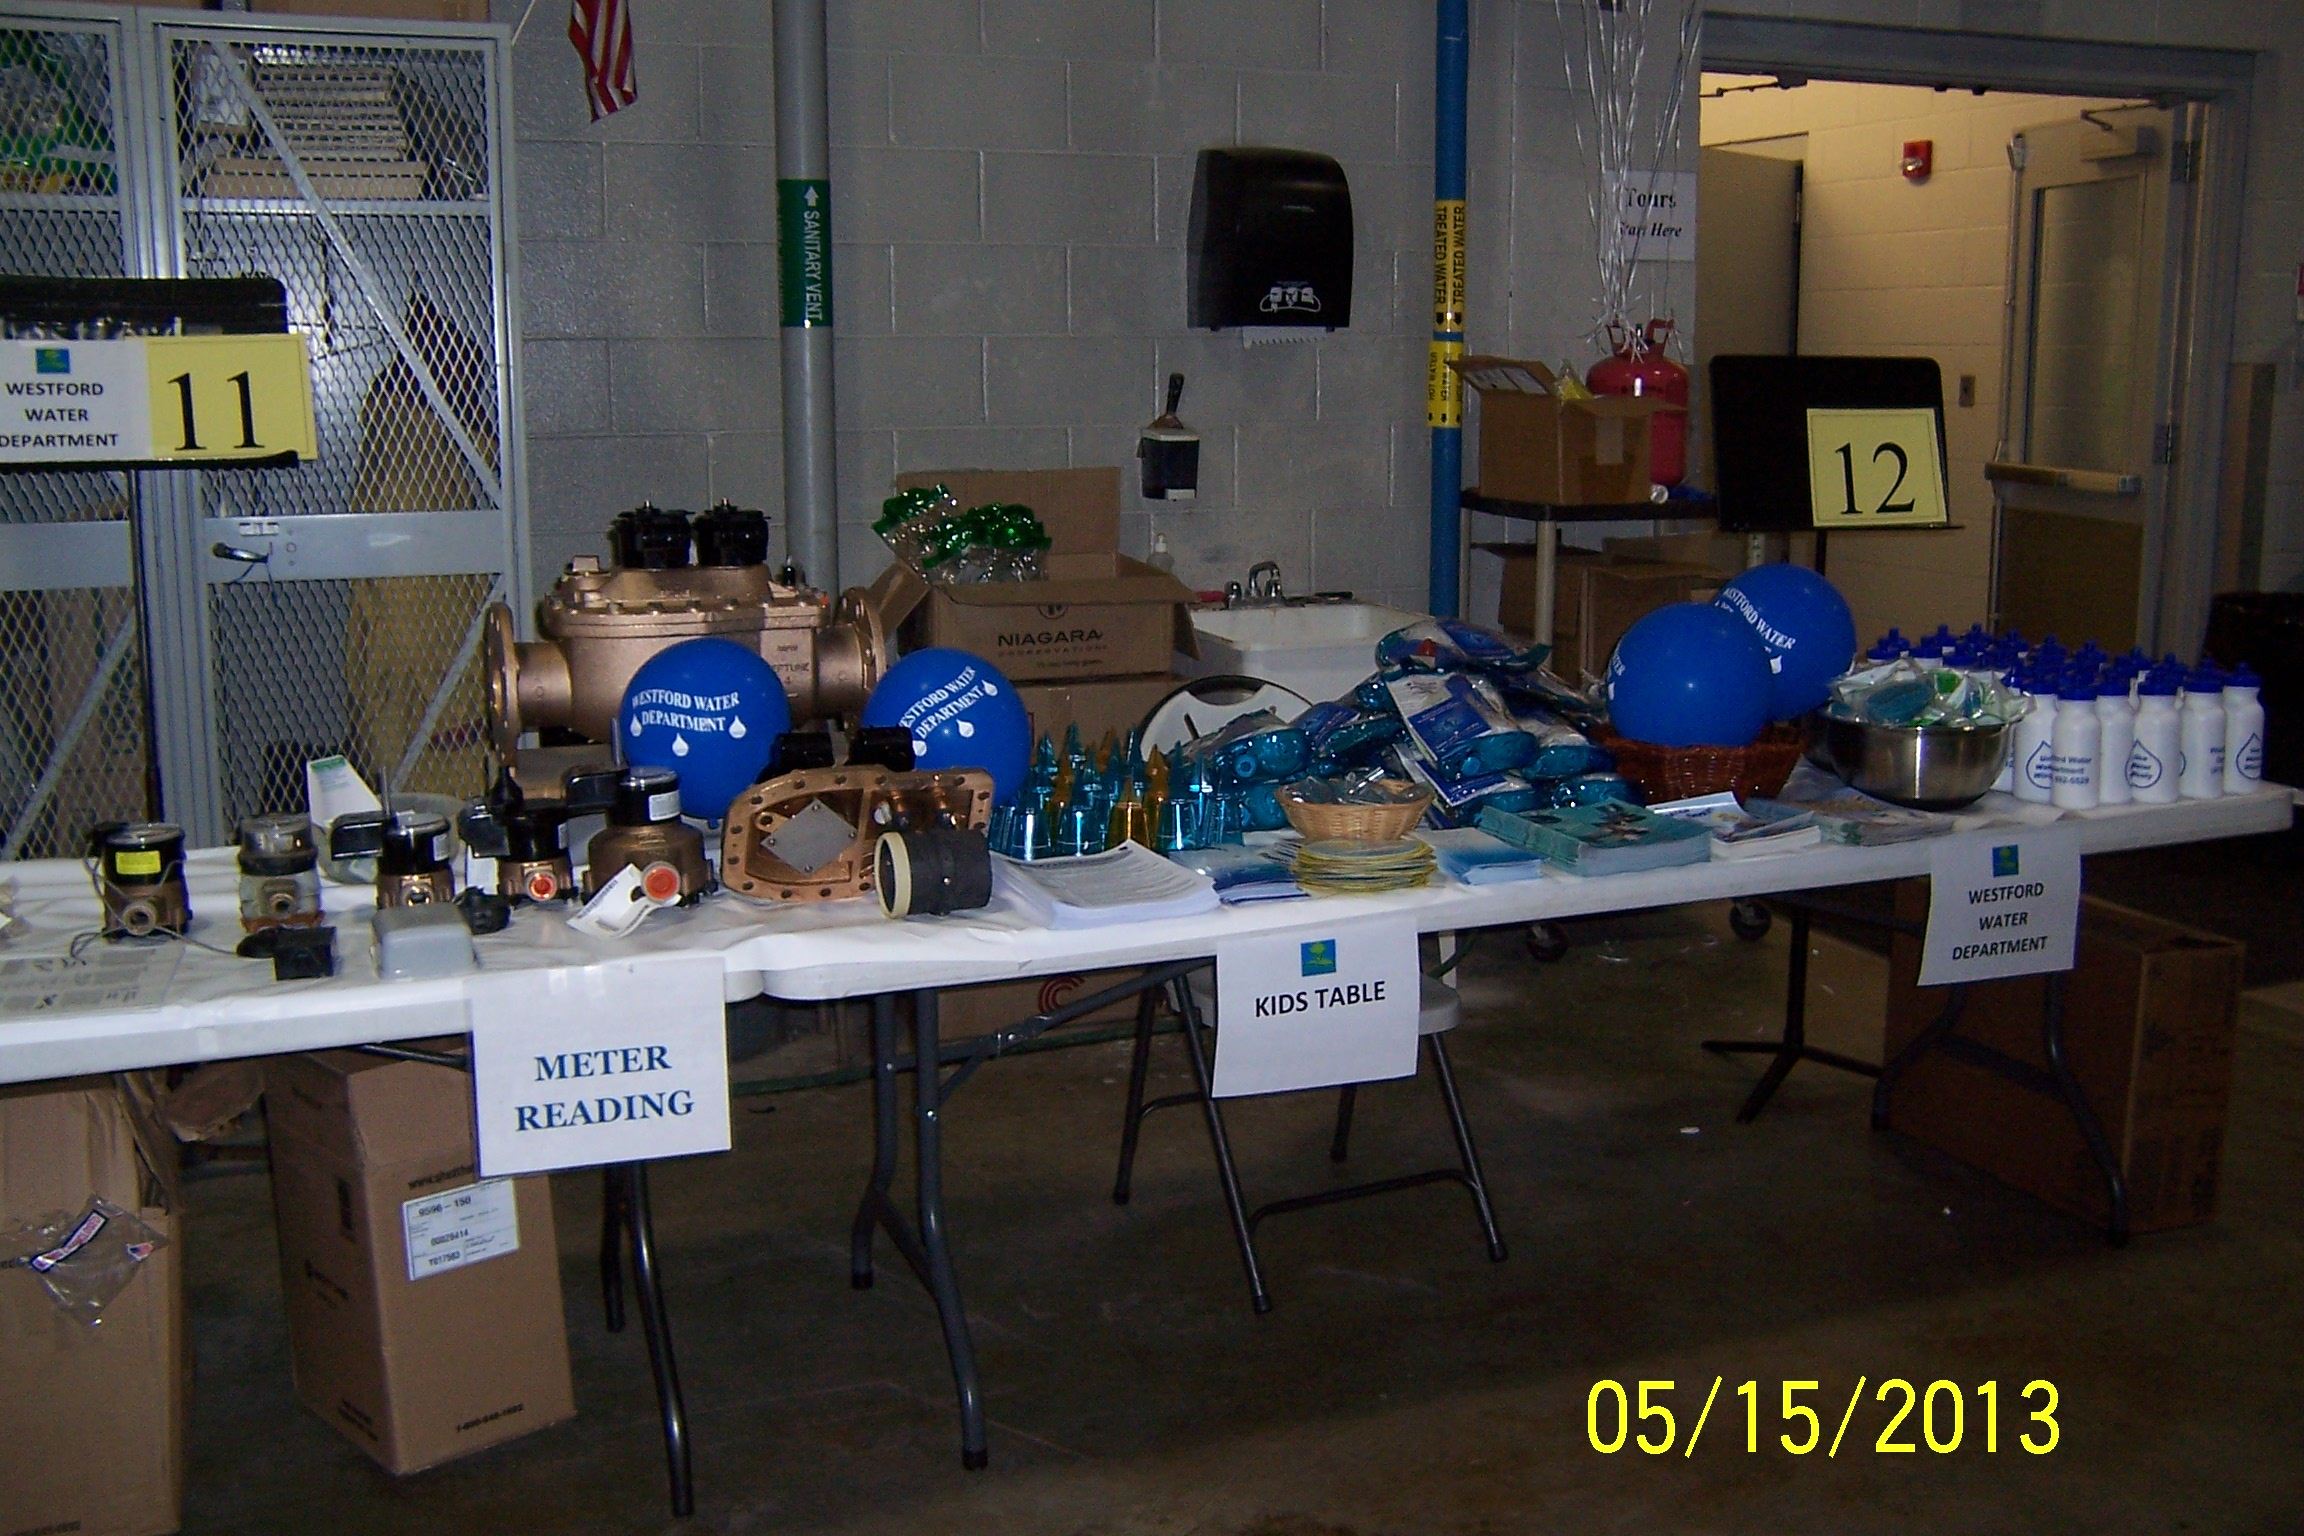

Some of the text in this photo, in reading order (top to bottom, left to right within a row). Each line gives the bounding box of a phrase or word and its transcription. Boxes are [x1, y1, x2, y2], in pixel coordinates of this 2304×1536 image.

[1624, 187, 1676, 209] Tours
[1650, 222, 1682, 237] Here
[803, 210, 823, 321] SANITARY VENT
[1434, 205, 1447, 304] TREATED WATER
[1453, 206, 1466, 304] TREATED WATER
[5, 382, 104, 396] WESTFORD
[24, 408, 89, 422] WATER
[168, 370, 265, 451] 11
[0, 433, 119, 449] DEPARTMENT
[1835, 441, 1916, 515] 12
[998, 629, 1103, 647] NIAGARA
[1756, 618, 1796, 650] WATER
[632, 689, 740, 711] WESTFORD WATER
[899, 665, 976, 729] ESTFORD WATER
[641, 710, 727, 732] DEPARTMENT
[915, 685, 984, 739] DEPARTMENT
[1968, 883, 2044, 904] WESTFORD
[1979, 912, 2028, 931] WATER
[1952, 936, 2048, 960] DEPARTMENT
[1255, 981, 1386, 1018] KIDS TABLE
[533, 1045, 672, 1081] METER
[514, 1090, 695, 1131] READING
